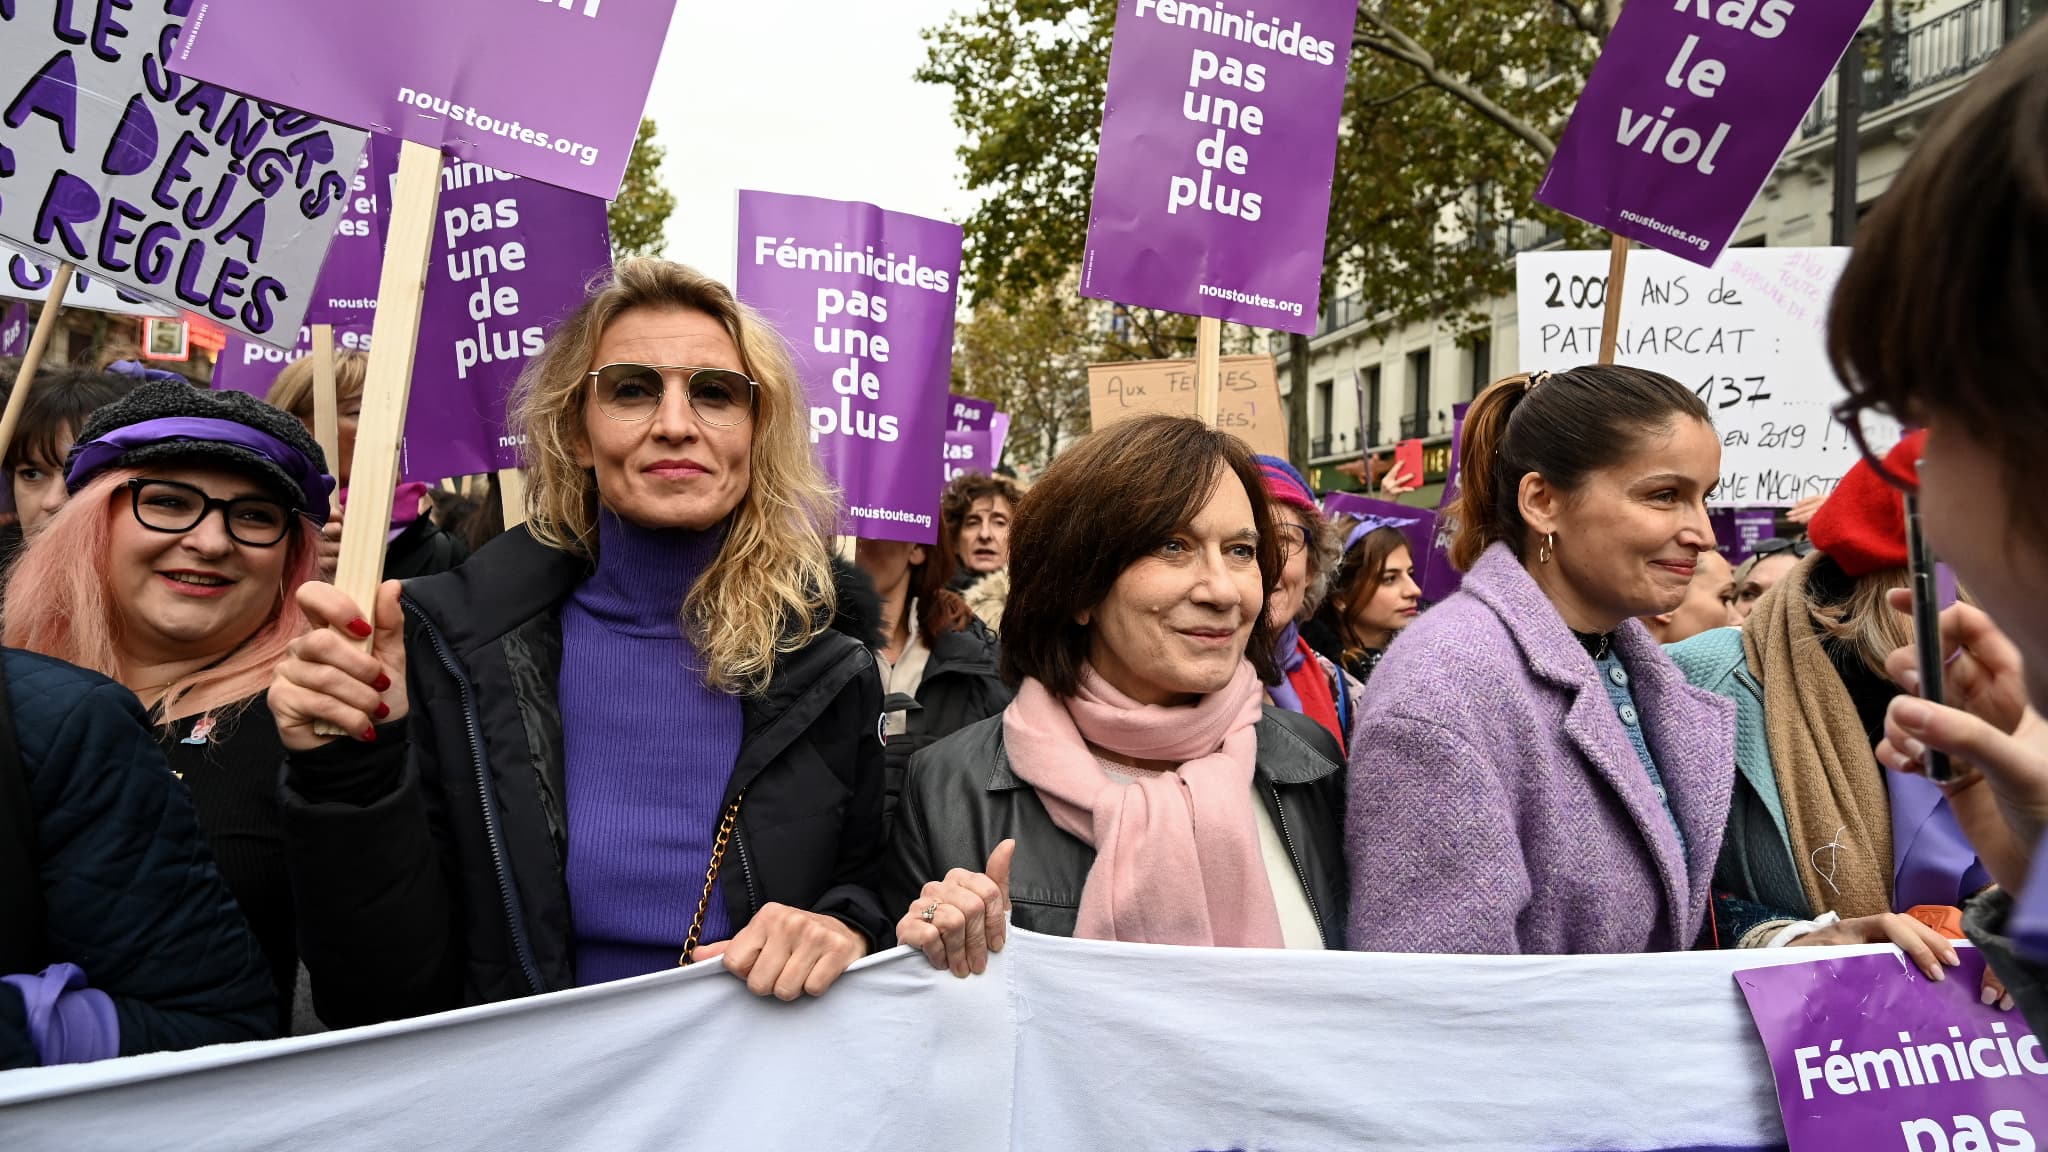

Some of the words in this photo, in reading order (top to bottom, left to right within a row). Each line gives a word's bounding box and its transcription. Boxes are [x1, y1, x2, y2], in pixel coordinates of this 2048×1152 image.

[1189, 48, 1266, 92] pas
[1665, 34, 1726, 98] le
[397, 86, 599, 165] noustoutes.org
[1183, 90, 1264, 136] une
[1196, 129, 1248, 174] de
[1616, 106, 1731, 175] viol
[101, 93, 266, 264] DEJA
[1168, 170, 1262, 221] plus
[444, 199, 519, 249] pas
[1619, 208, 1710, 251] noustoutes.org
[34, 169, 288, 334] REGLES
[447, 241, 526, 282] une
[755, 236, 950, 294] Féminicides
[468, 277, 519, 321] de
[817, 287, 888, 323] pas
[1199, 284, 1303, 316] noustoutes.org
[1641, 276, 1689, 307] ANS
[1708, 276, 1743, 304] de
[455, 323, 546, 378] plus
[813, 326, 890, 363] une
[832, 358, 880, 400] de
[1107, 376, 1147, 408] Aux
[1165, 371, 1257, 393] FEES
[1695, 374, 1772, 409] 137
[810, 397, 899, 443] plus
[953, 403, 981, 420] Ras
[1723, 430, 1749, 447] EN
[1757, 421, 1807, 449] 2019
[850, 504, 932, 528] noustoutes.org
